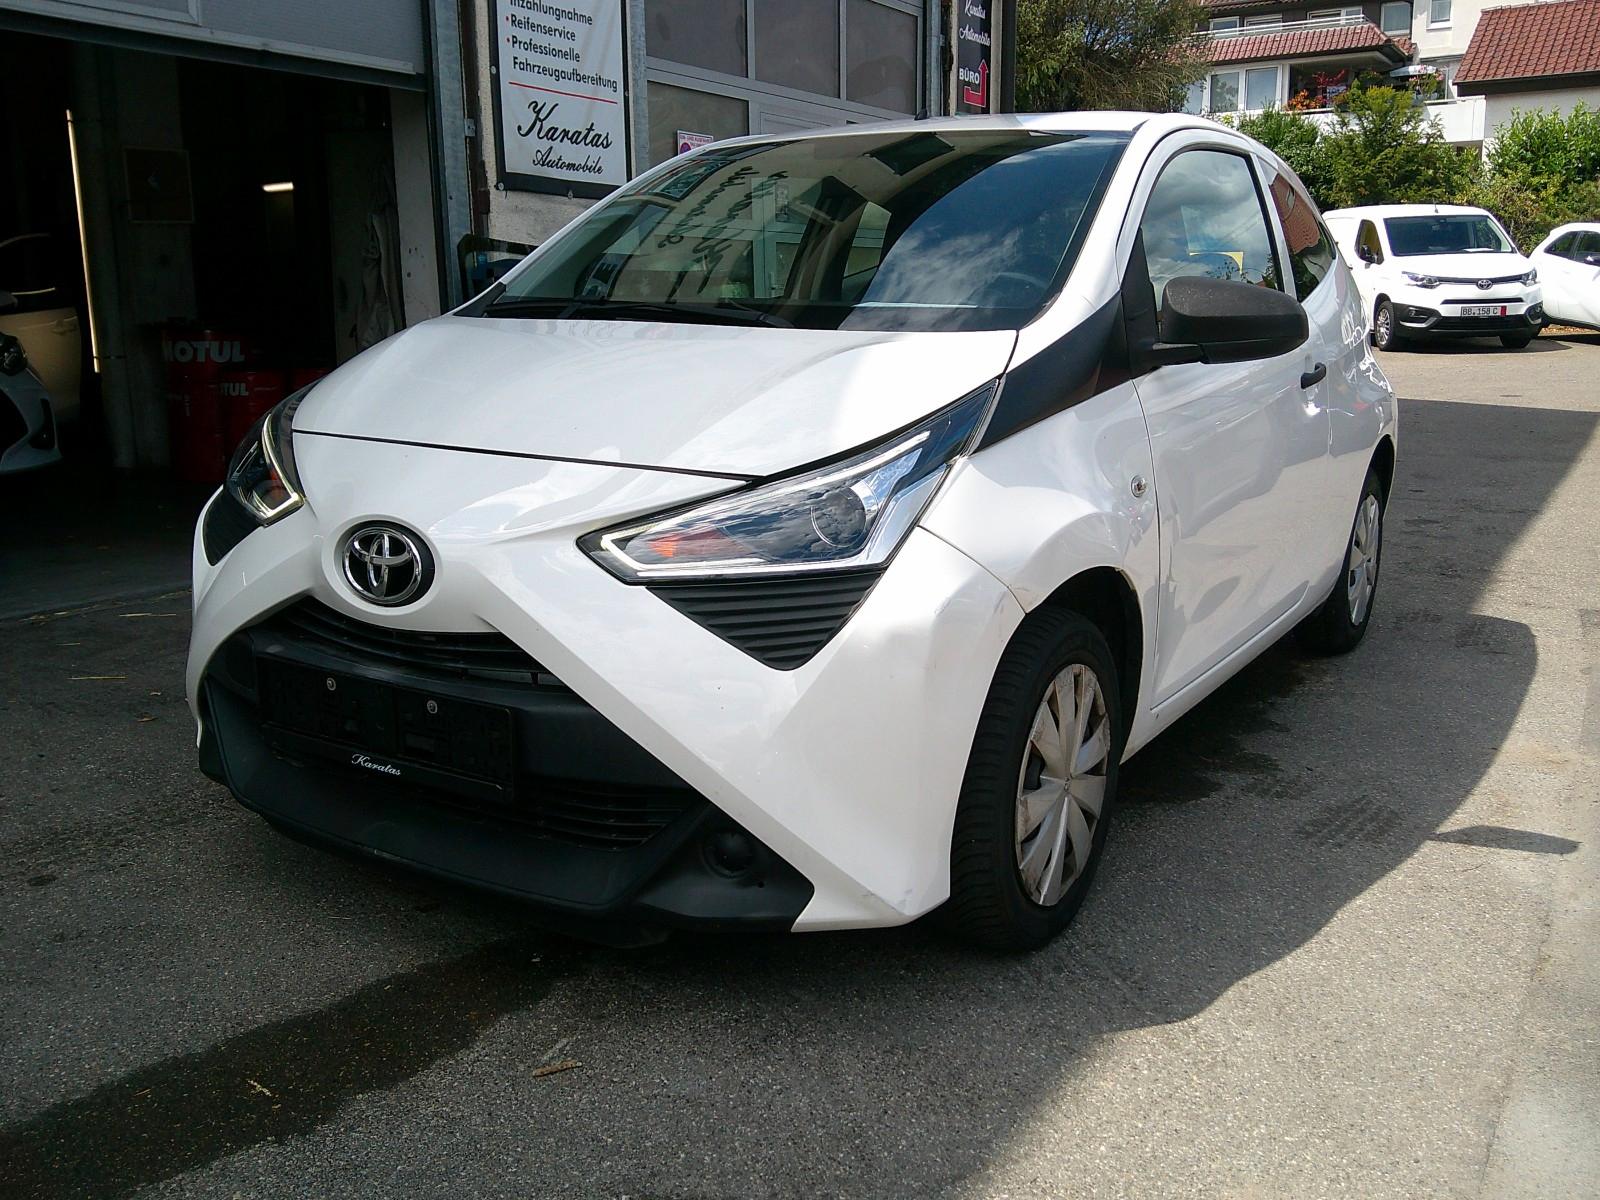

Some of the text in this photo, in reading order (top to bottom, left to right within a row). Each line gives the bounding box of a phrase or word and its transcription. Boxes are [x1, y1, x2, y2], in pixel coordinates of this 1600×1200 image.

[510, 13, 576, 42] Reifenservice
[511, 35, 581, 63] Professionelle
[513, 56, 618, 92] Fahrzeugaufbereitung
[959, 67, 980, 84] BÜRO
[517, 100, 613, 149] Karatas
[532, 146, 604, 175] Automobile
[351, 753, 401, 776] Karatas
